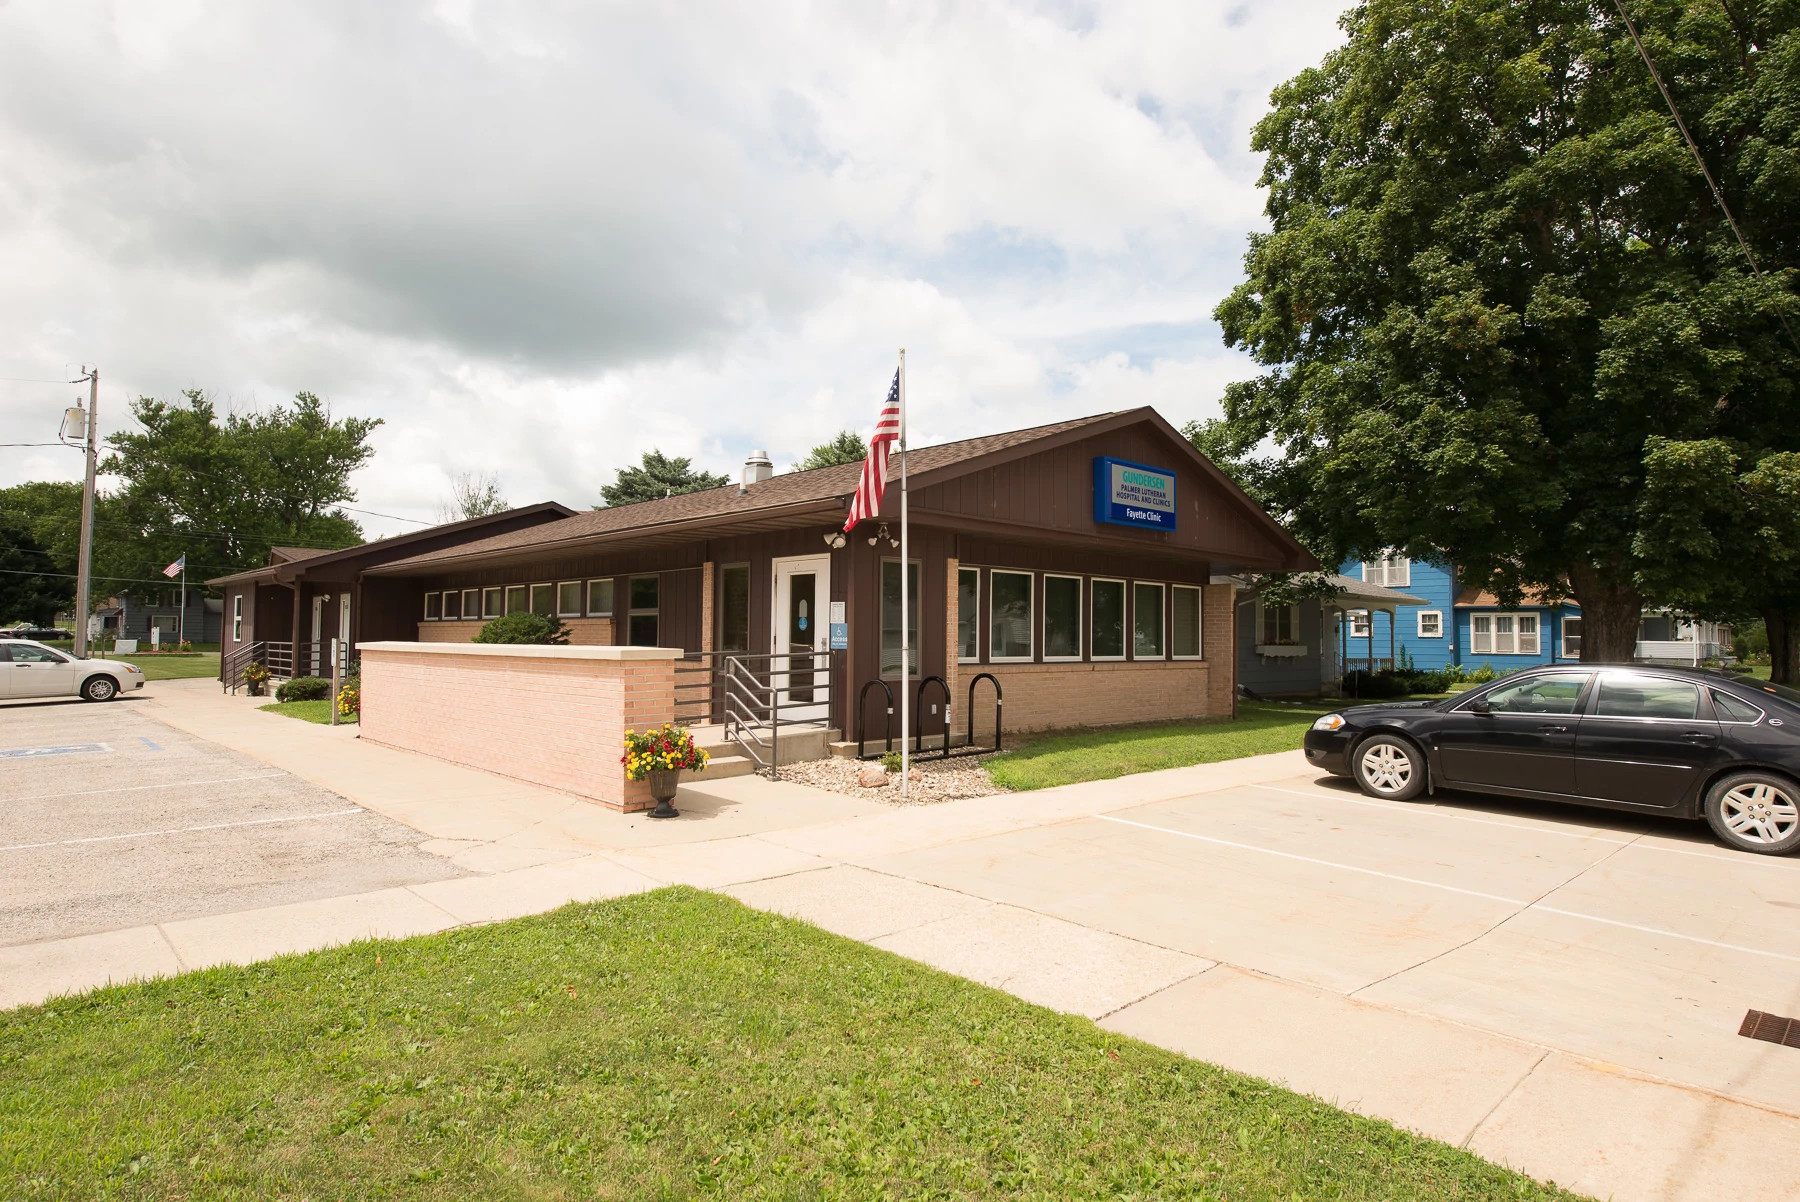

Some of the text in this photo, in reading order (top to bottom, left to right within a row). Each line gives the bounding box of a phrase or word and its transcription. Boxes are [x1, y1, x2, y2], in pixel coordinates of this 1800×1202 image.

[1122, 470, 1164, 490] GUNDERSEN
[1121, 484, 1166, 498] PALMER LUTHERAN
[1116, 491, 1140, 502] HOSPITAL
[1153, 498, 1171, 507] CLINICS
[1126, 508, 1162, 522] Fayette Clinic
